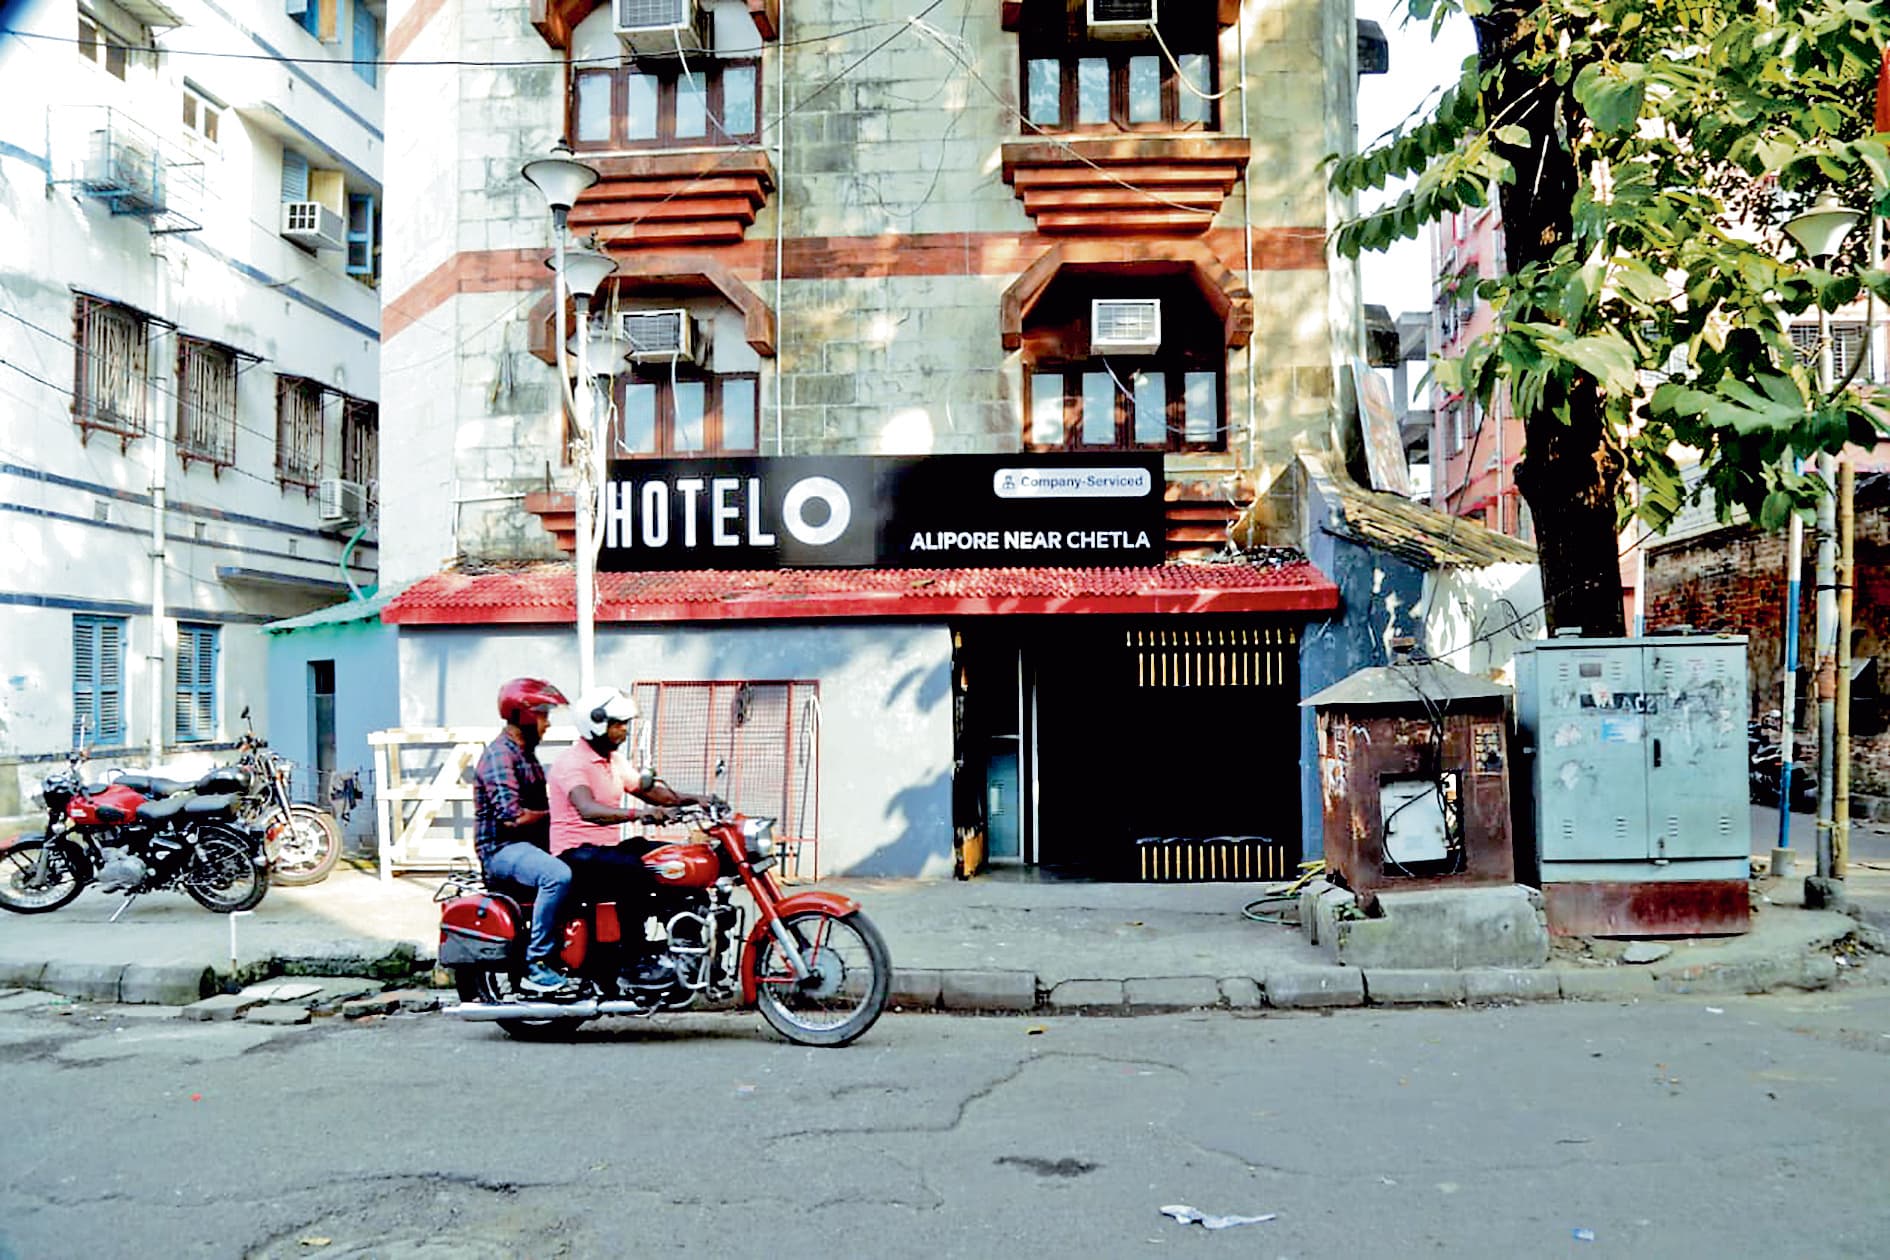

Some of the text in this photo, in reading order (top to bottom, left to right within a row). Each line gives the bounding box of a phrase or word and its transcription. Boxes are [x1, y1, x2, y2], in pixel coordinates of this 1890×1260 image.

[1020, 475, 1144, 489] Company-Serviced
[606, 477, 776, 548] HOTEL
[910, 530, 1151, 550] ALIPORE NEAR CHETLA
